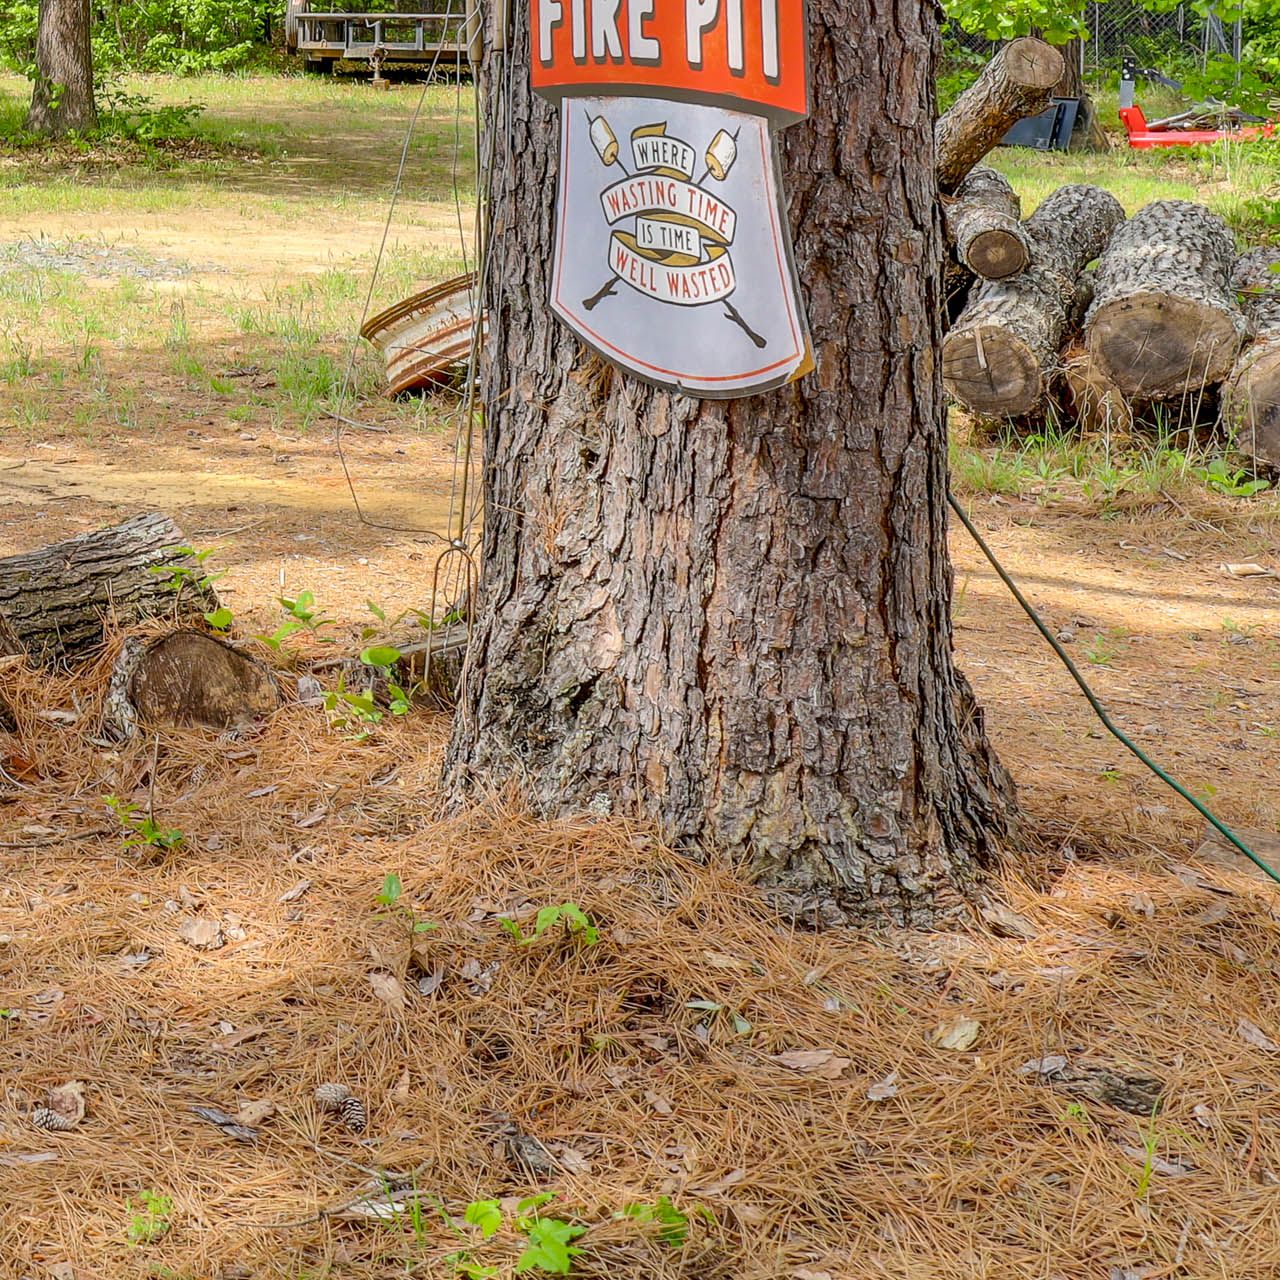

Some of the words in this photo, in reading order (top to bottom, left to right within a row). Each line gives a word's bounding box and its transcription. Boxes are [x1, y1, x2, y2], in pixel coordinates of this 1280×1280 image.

[637, 141, 689, 170] WHERE
[607, 180, 677, 217] WASTING
[688, 187, 729, 235] TIME
[641, 223, 653, 244] IS
[660, 226, 693, 252] TIME
[616, 246, 657, 292] WELL
[666, 263, 732, 299] WASTED
